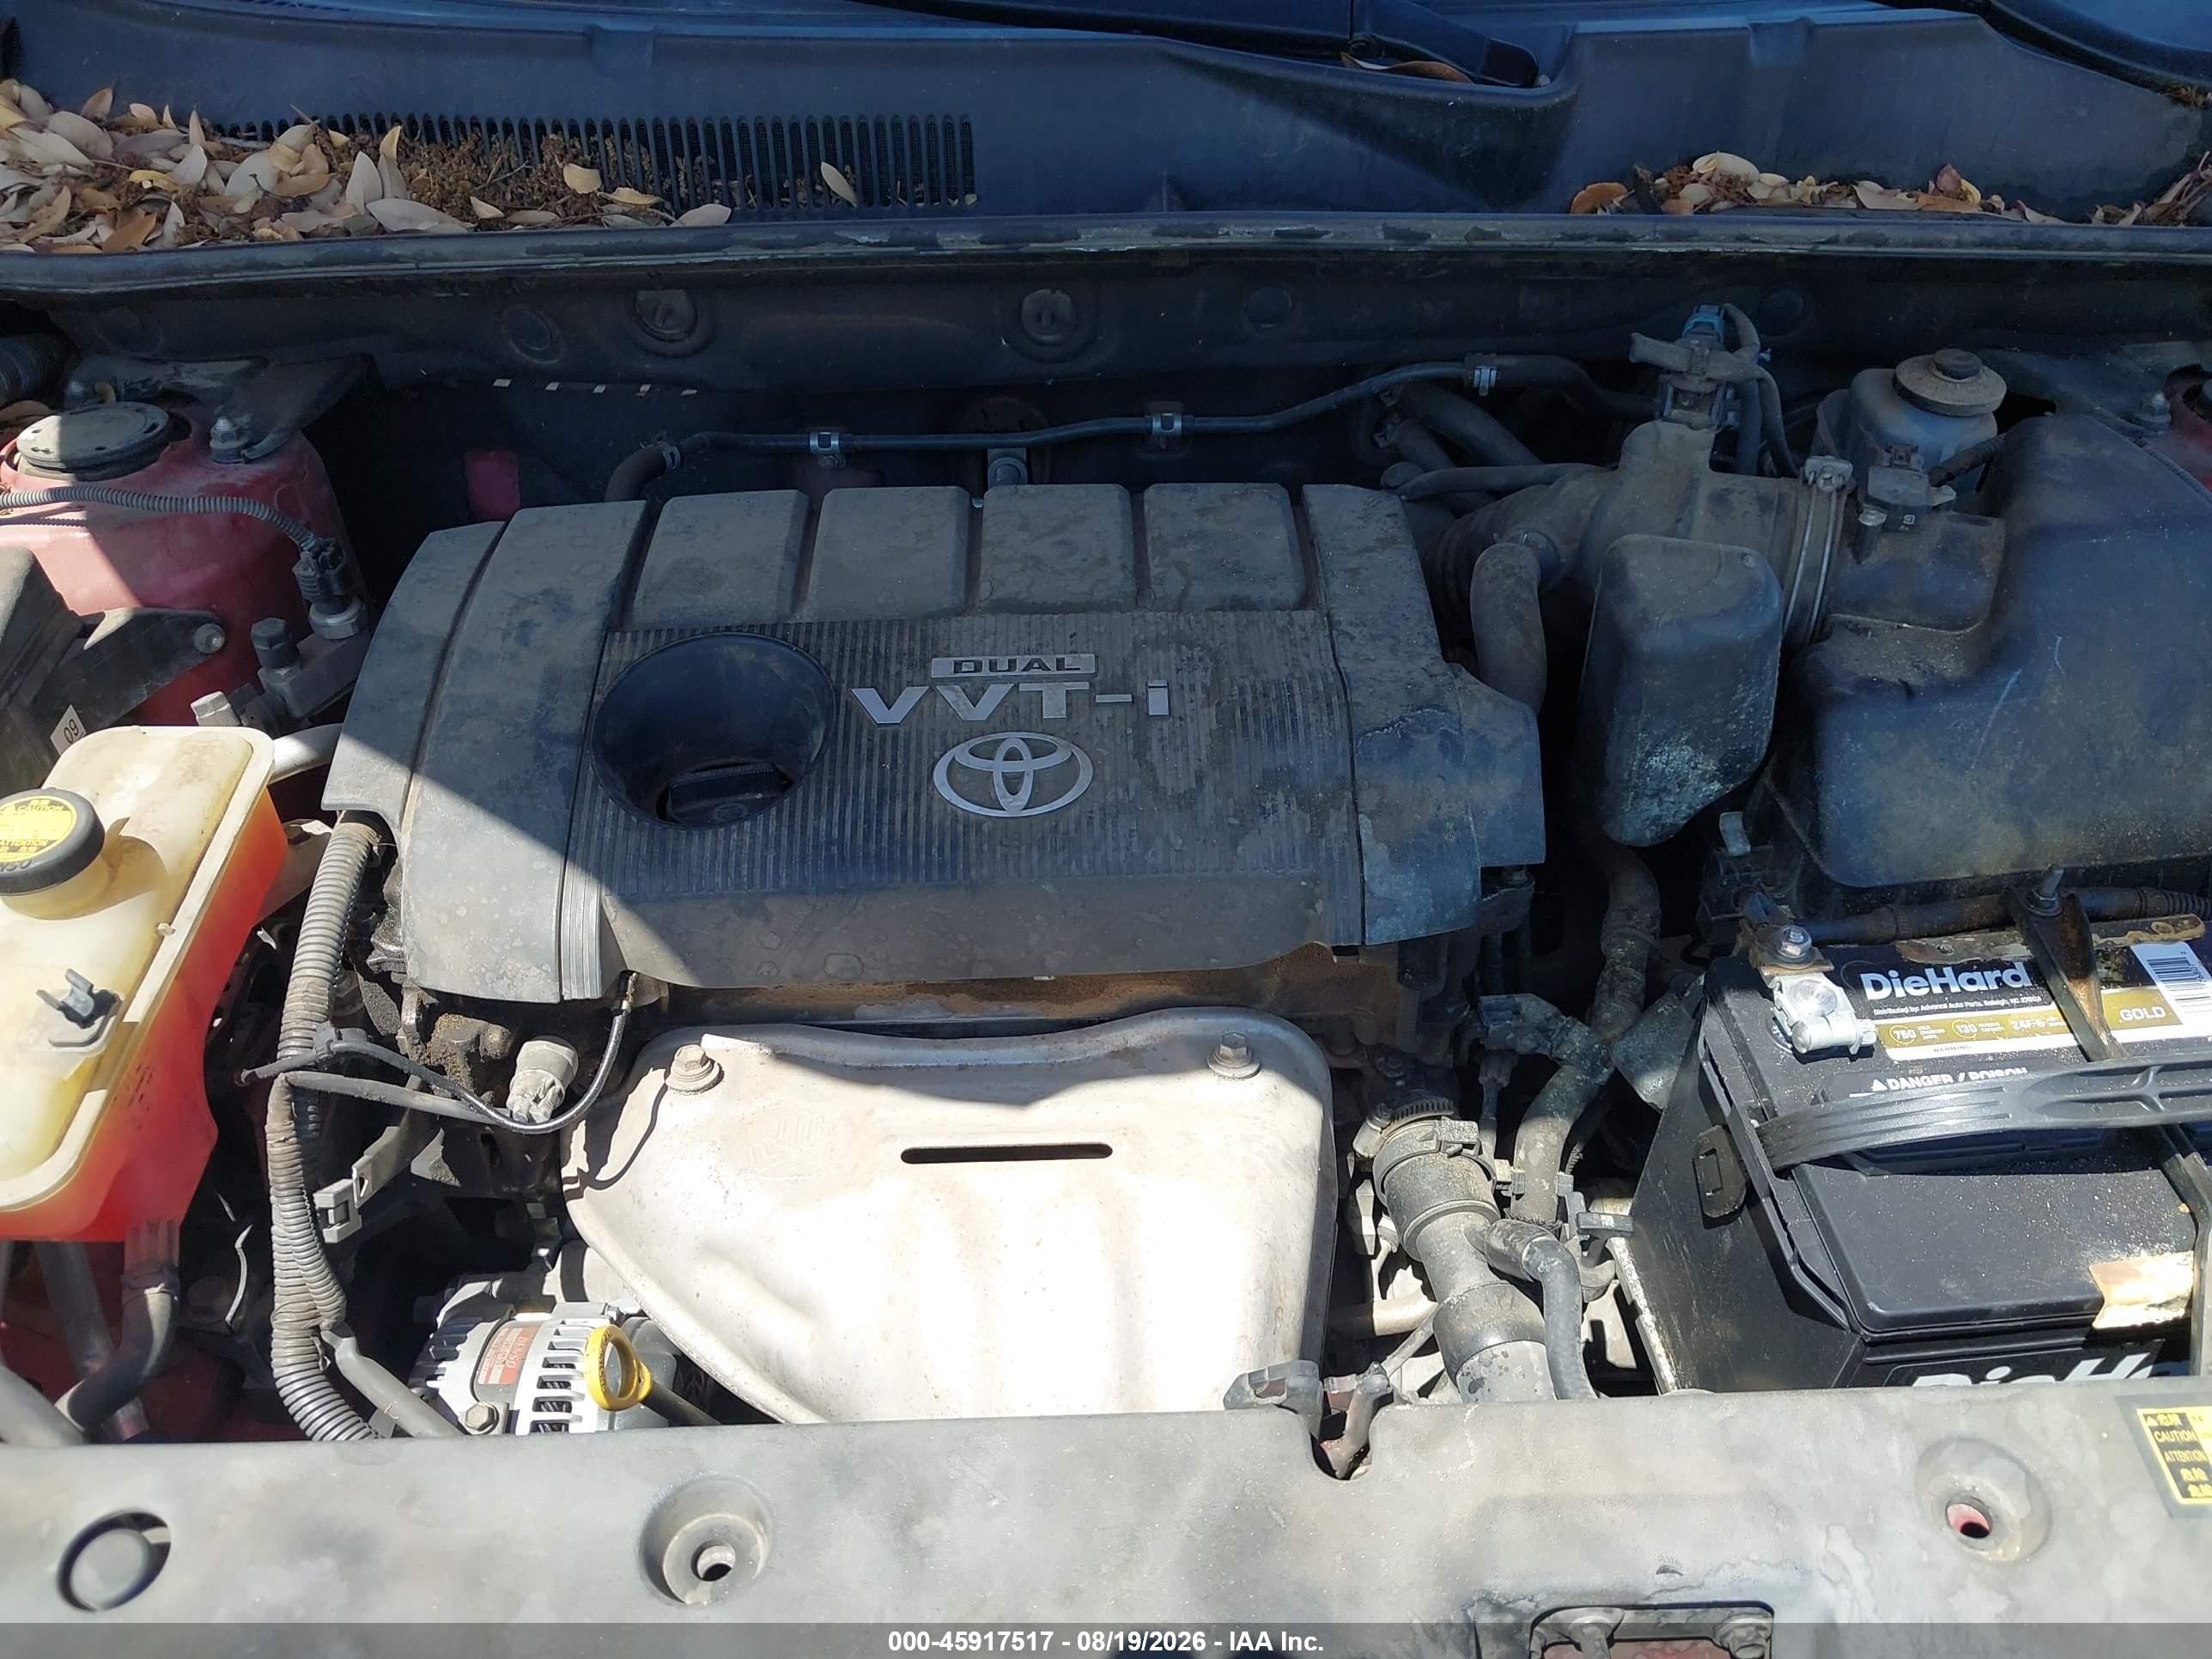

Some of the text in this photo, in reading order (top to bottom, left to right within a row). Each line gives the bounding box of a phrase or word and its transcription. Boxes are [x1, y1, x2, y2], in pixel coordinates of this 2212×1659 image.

[953, 658, 1081, 674] DUAL
[851, 680, 1170, 724] VVT-i
[1860, 962, 2033, 1000] DieHard
[2119, 1006, 2166, 1021] GOLD
[1887, 1074, 1954, 1091] DANGER
[507, 1334, 526, 1369] DENSO
[2154, 1430, 2198, 1443] CAUTION
[2163, 1449, 2209, 1462] ATTENTION
